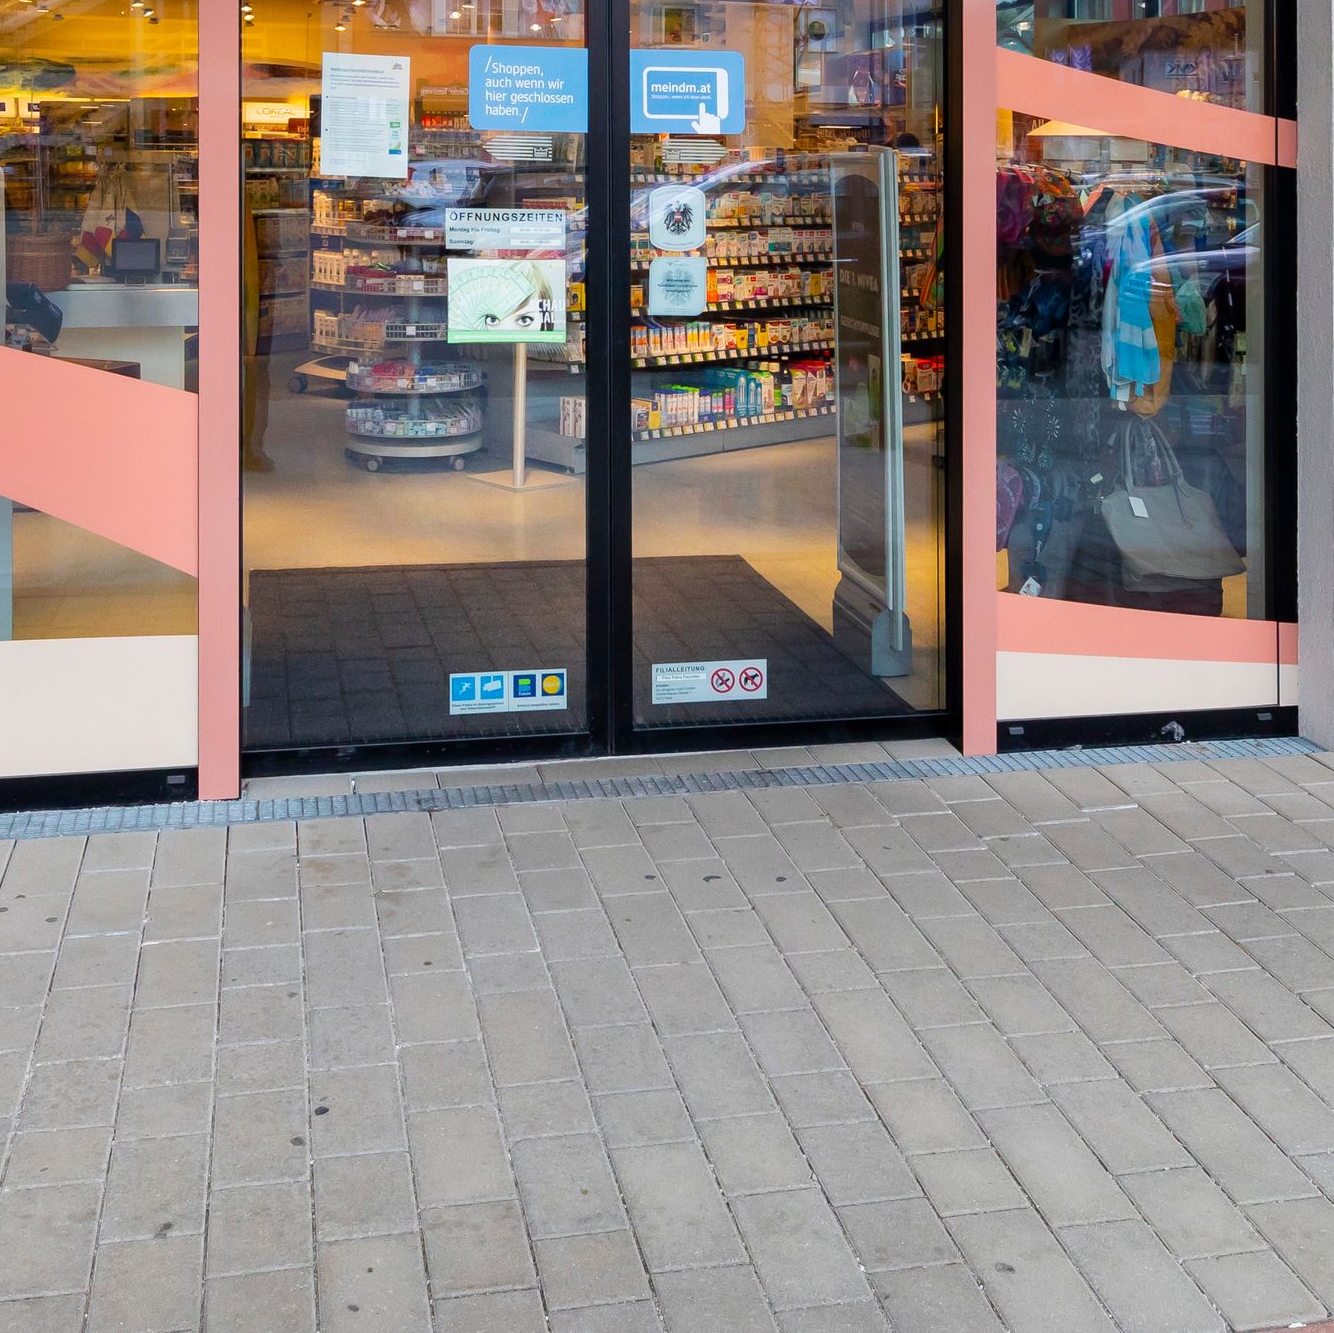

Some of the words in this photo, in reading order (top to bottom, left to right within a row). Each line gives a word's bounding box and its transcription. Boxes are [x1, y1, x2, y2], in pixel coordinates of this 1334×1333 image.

[485, 77, 512, 89] auch
[515, 79, 545, 90] wenn
[548, 79, 565, 90] wir
[650, 81, 712, 94] meindm.at
[485, 90, 507, 102] hier
[510, 92, 574, 106] geschlossen
[449, 210, 563, 222] ÖFFNUNGSZEITEN
[449, 226, 470, 234] Montag
